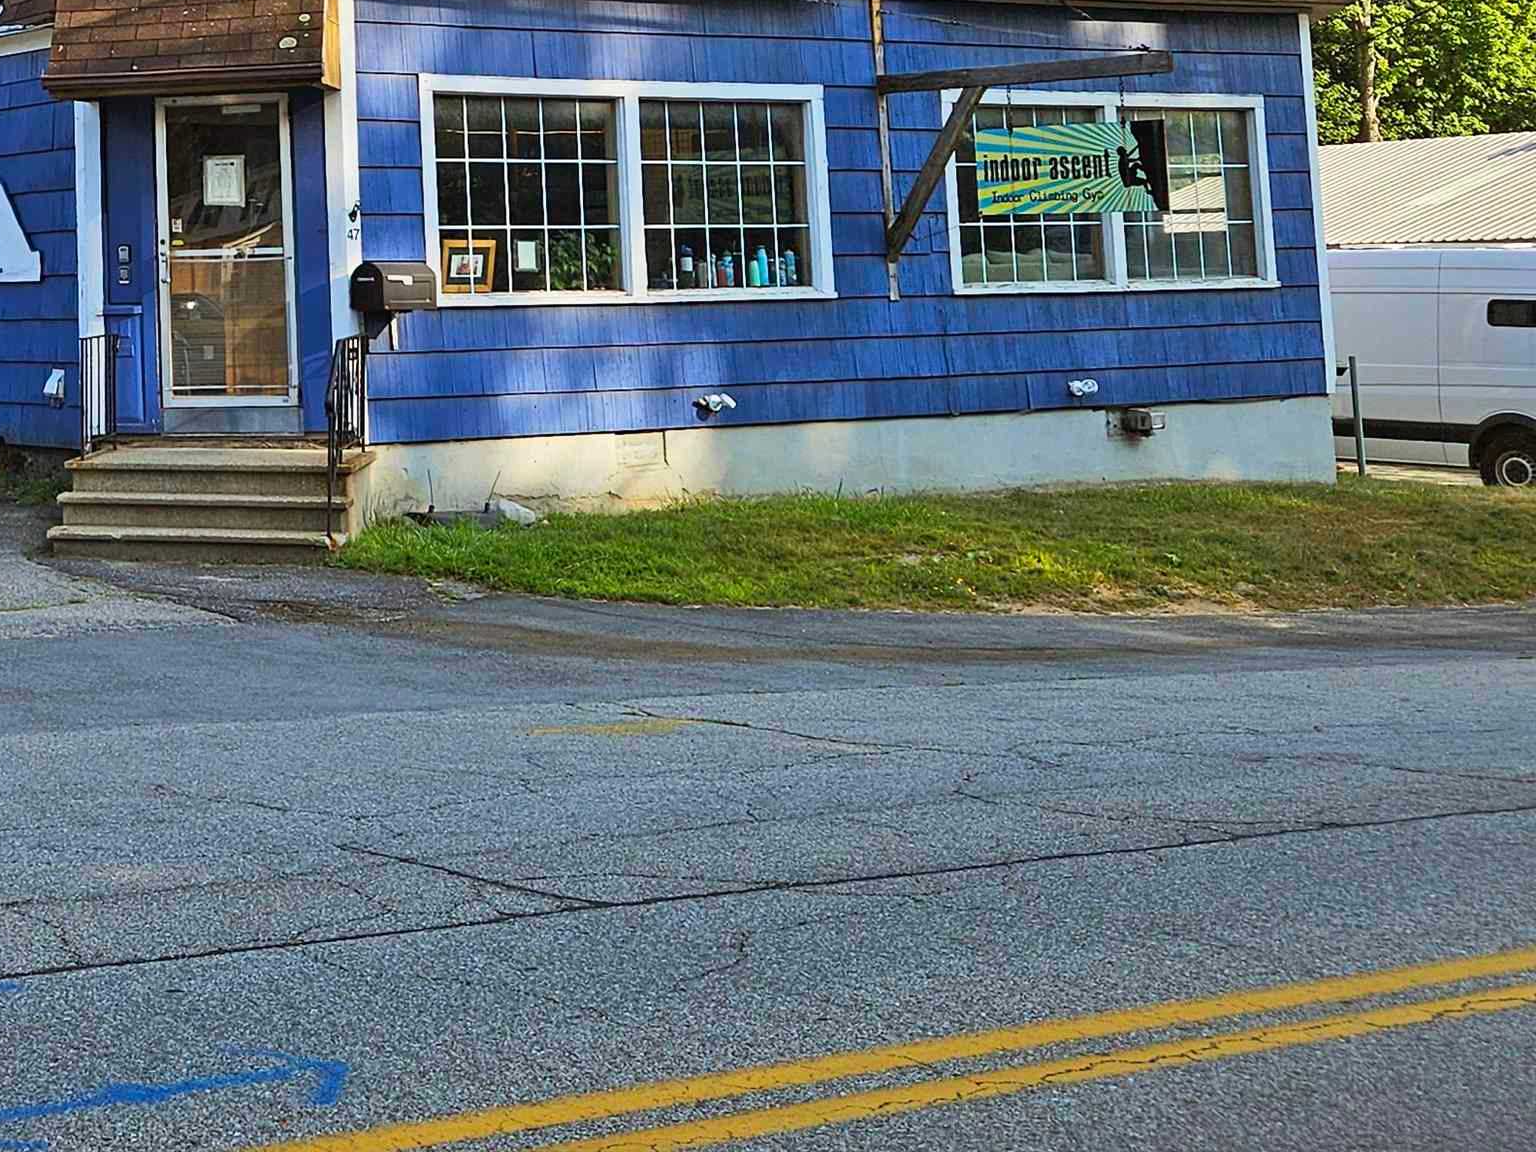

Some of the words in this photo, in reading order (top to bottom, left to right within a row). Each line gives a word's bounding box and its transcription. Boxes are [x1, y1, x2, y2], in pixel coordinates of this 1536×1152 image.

[983, 154, 1041, 182] indoor
[1048, 150, 1112, 180] ascent
[991, 191, 1024, 204] Indoor
[347, 228, 360, 241] 47
